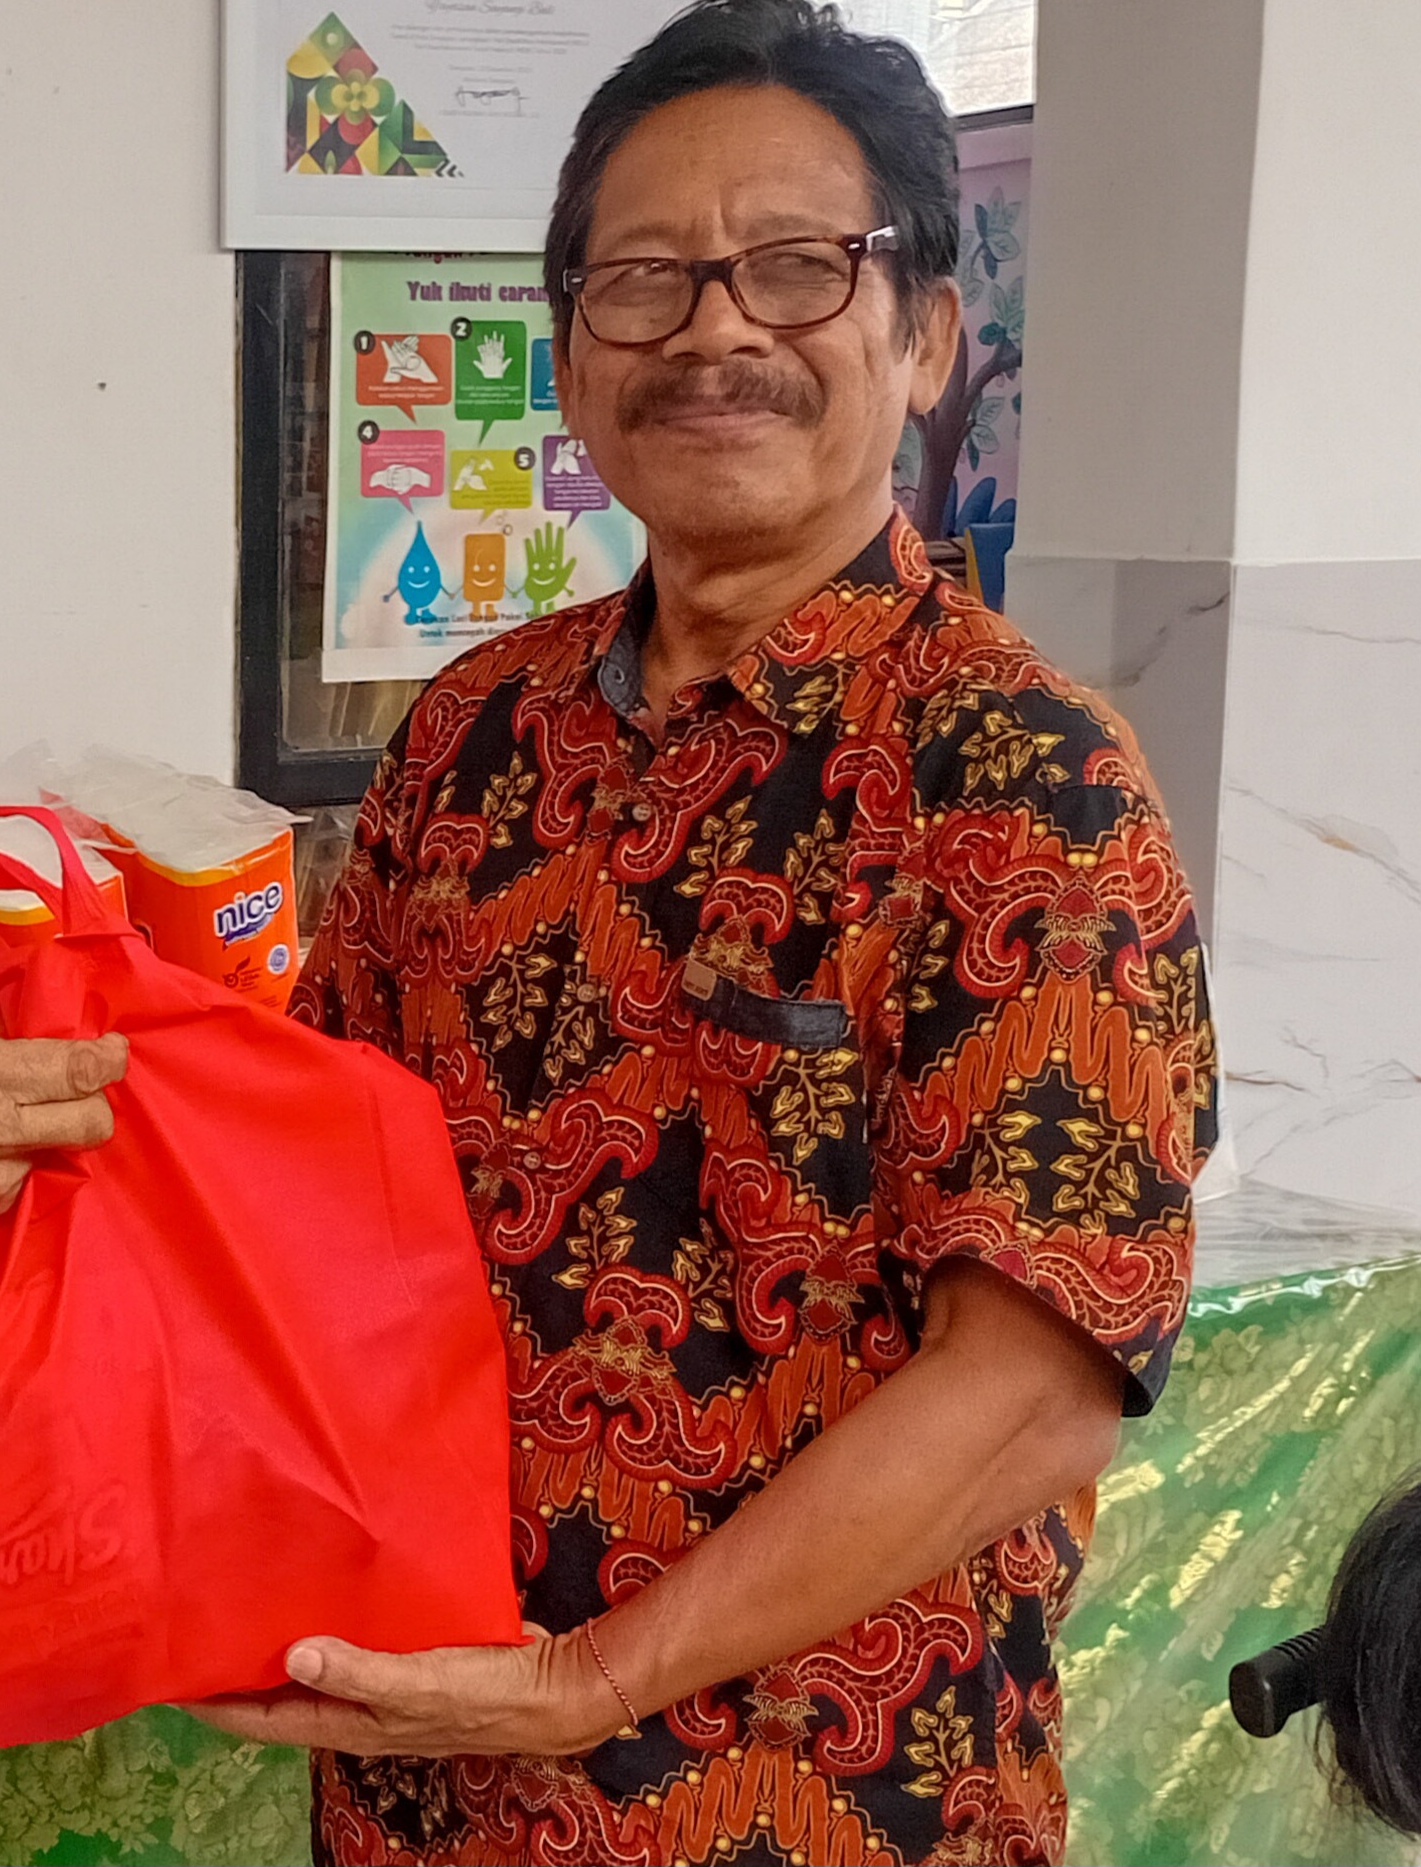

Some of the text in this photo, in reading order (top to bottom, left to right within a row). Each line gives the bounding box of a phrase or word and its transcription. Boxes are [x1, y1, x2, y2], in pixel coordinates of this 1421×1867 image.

[407, 281, 550, 302] Yuk ikuti caran
[456, 323, 467, 336] 2
[361, 336, 368, 350] 1
[362, 425, 373, 439] 4
[518, 453, 529, 465] 5
[215, 883, 282, 935] nice
